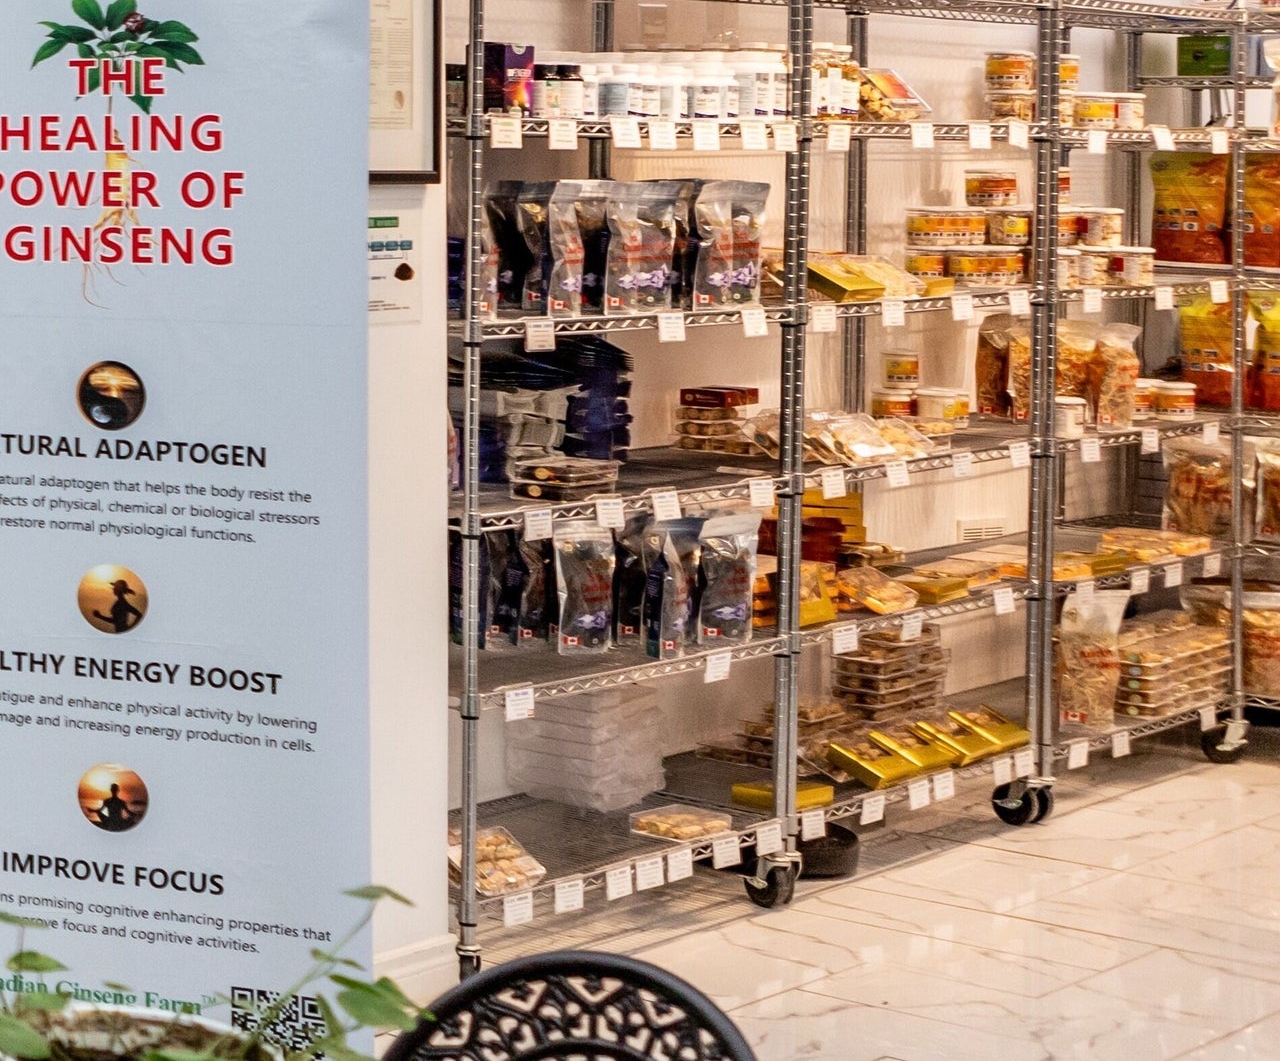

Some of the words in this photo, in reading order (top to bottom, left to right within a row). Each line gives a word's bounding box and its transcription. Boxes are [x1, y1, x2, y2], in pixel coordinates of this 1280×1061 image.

[69, 59, 166, 96] THE
[0, 114, 224, 152] HEALING
[180, 171, 247, 209] OF
[4, 226, 235, 266] GINSENG
[95, 438, 267, 468] ADAPTOGEN
[39, 476, 110, 492] adaptogen
[113, 480, 140, 493] that
[145, 481, 181, 495] helps
[185, 484, 207, 496] the
[211, 485, 245, 501] body
[249, 488, 285, 501] resist
[289, 491, 312, 503] the
[0, 516, 46, 529] restore
[49, 518, 95, 532] normal
[99, 521, 187, 539] physiological
[191, 526, 257, 543] functions.
[32, 496, 47, 508] of
[49, 496, 104, 513] physical,
[108, 501, 167, 515] chemical
[171, 506, 186, 516] or
[191, 505, 255, 522] biological
[259, 511, 320, 525] stressors
[74, 656, 180, 684] ENERGY
[190, 665, 283, 695] BOOST
[39, 694, 64, 707] and
[68, 696, 123, 713] enhance
[127, 701, 181, 718] physical
[185, 706, 233, 724] activity
[237, 711, 254, 727] by
[258, 713, 318, 734] lowering
[36, 715, 60, 727] and
[64, 716, 131, 737] increasing
[136, 725, 183, 741] energy
[187, 728, 261, 747] production
[265, 735, 278, 748] in
[281, 737, 316, 753] cells.
[3, 851, 125, 886] IMPROVE
[135, 866, 225, 896] FOCUS
[18, 893, 84, 913] promising
[88, 902, 150, 919] cognitive
[153, 909, 224, 930] enhancing
[228, 918, 299, 938] properties
[302, 927, 332, 942] that
[62, 918, 98, 934] focus
[101, 925, 127, 938] and
[131, 928, 193, 946] cognitive
[197, 936, 260, 954] activities.
[55, 980, 137, 1007] Ginseng
